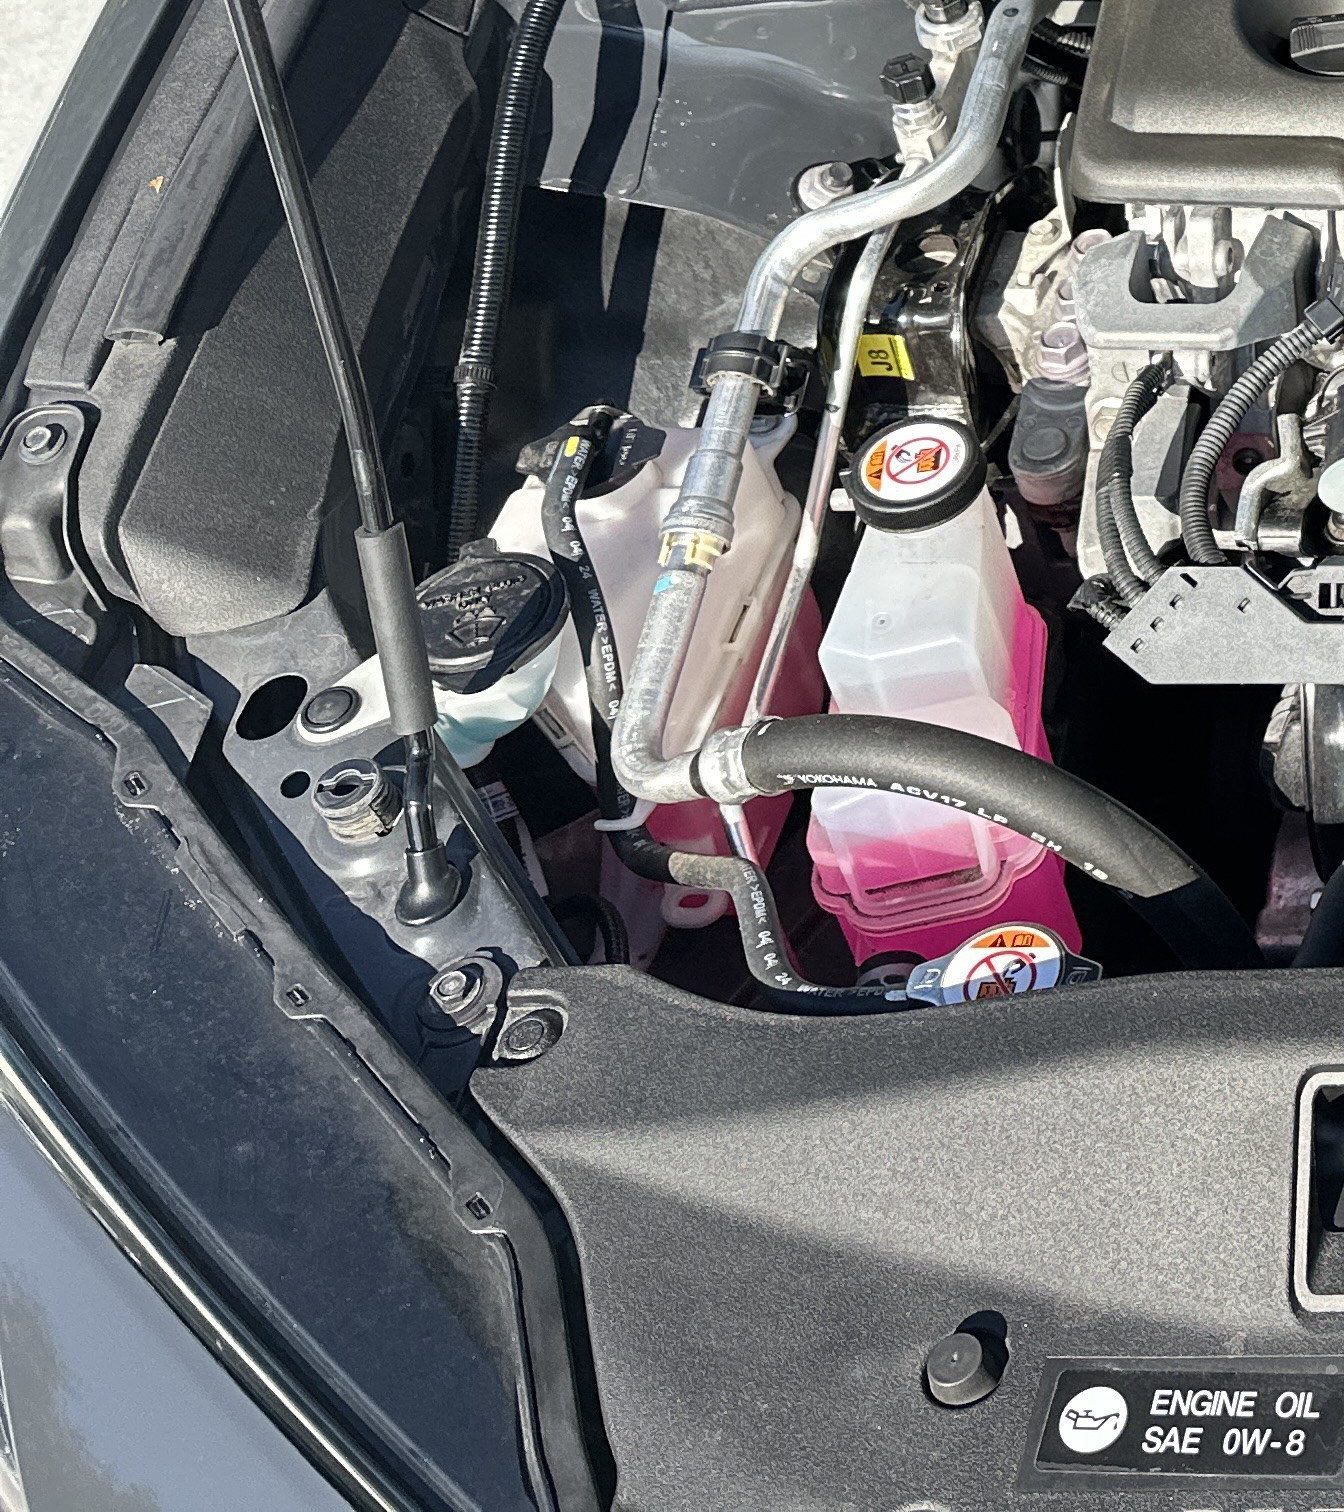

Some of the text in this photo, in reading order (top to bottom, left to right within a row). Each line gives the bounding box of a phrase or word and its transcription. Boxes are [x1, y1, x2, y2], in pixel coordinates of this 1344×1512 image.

[867, 348, 894, 372] J8
[571, 438, 592, 470] WATER
[587, 588, 609, 634] WATER
[798, 774, 879, 788] YOKOHAMA
[890, 782, 967, 808] ACV17
[1150, 1389, 1320, 1418] ENGINE OIL
[1141, 1426, 1306, 1456] SAE 0W-8
